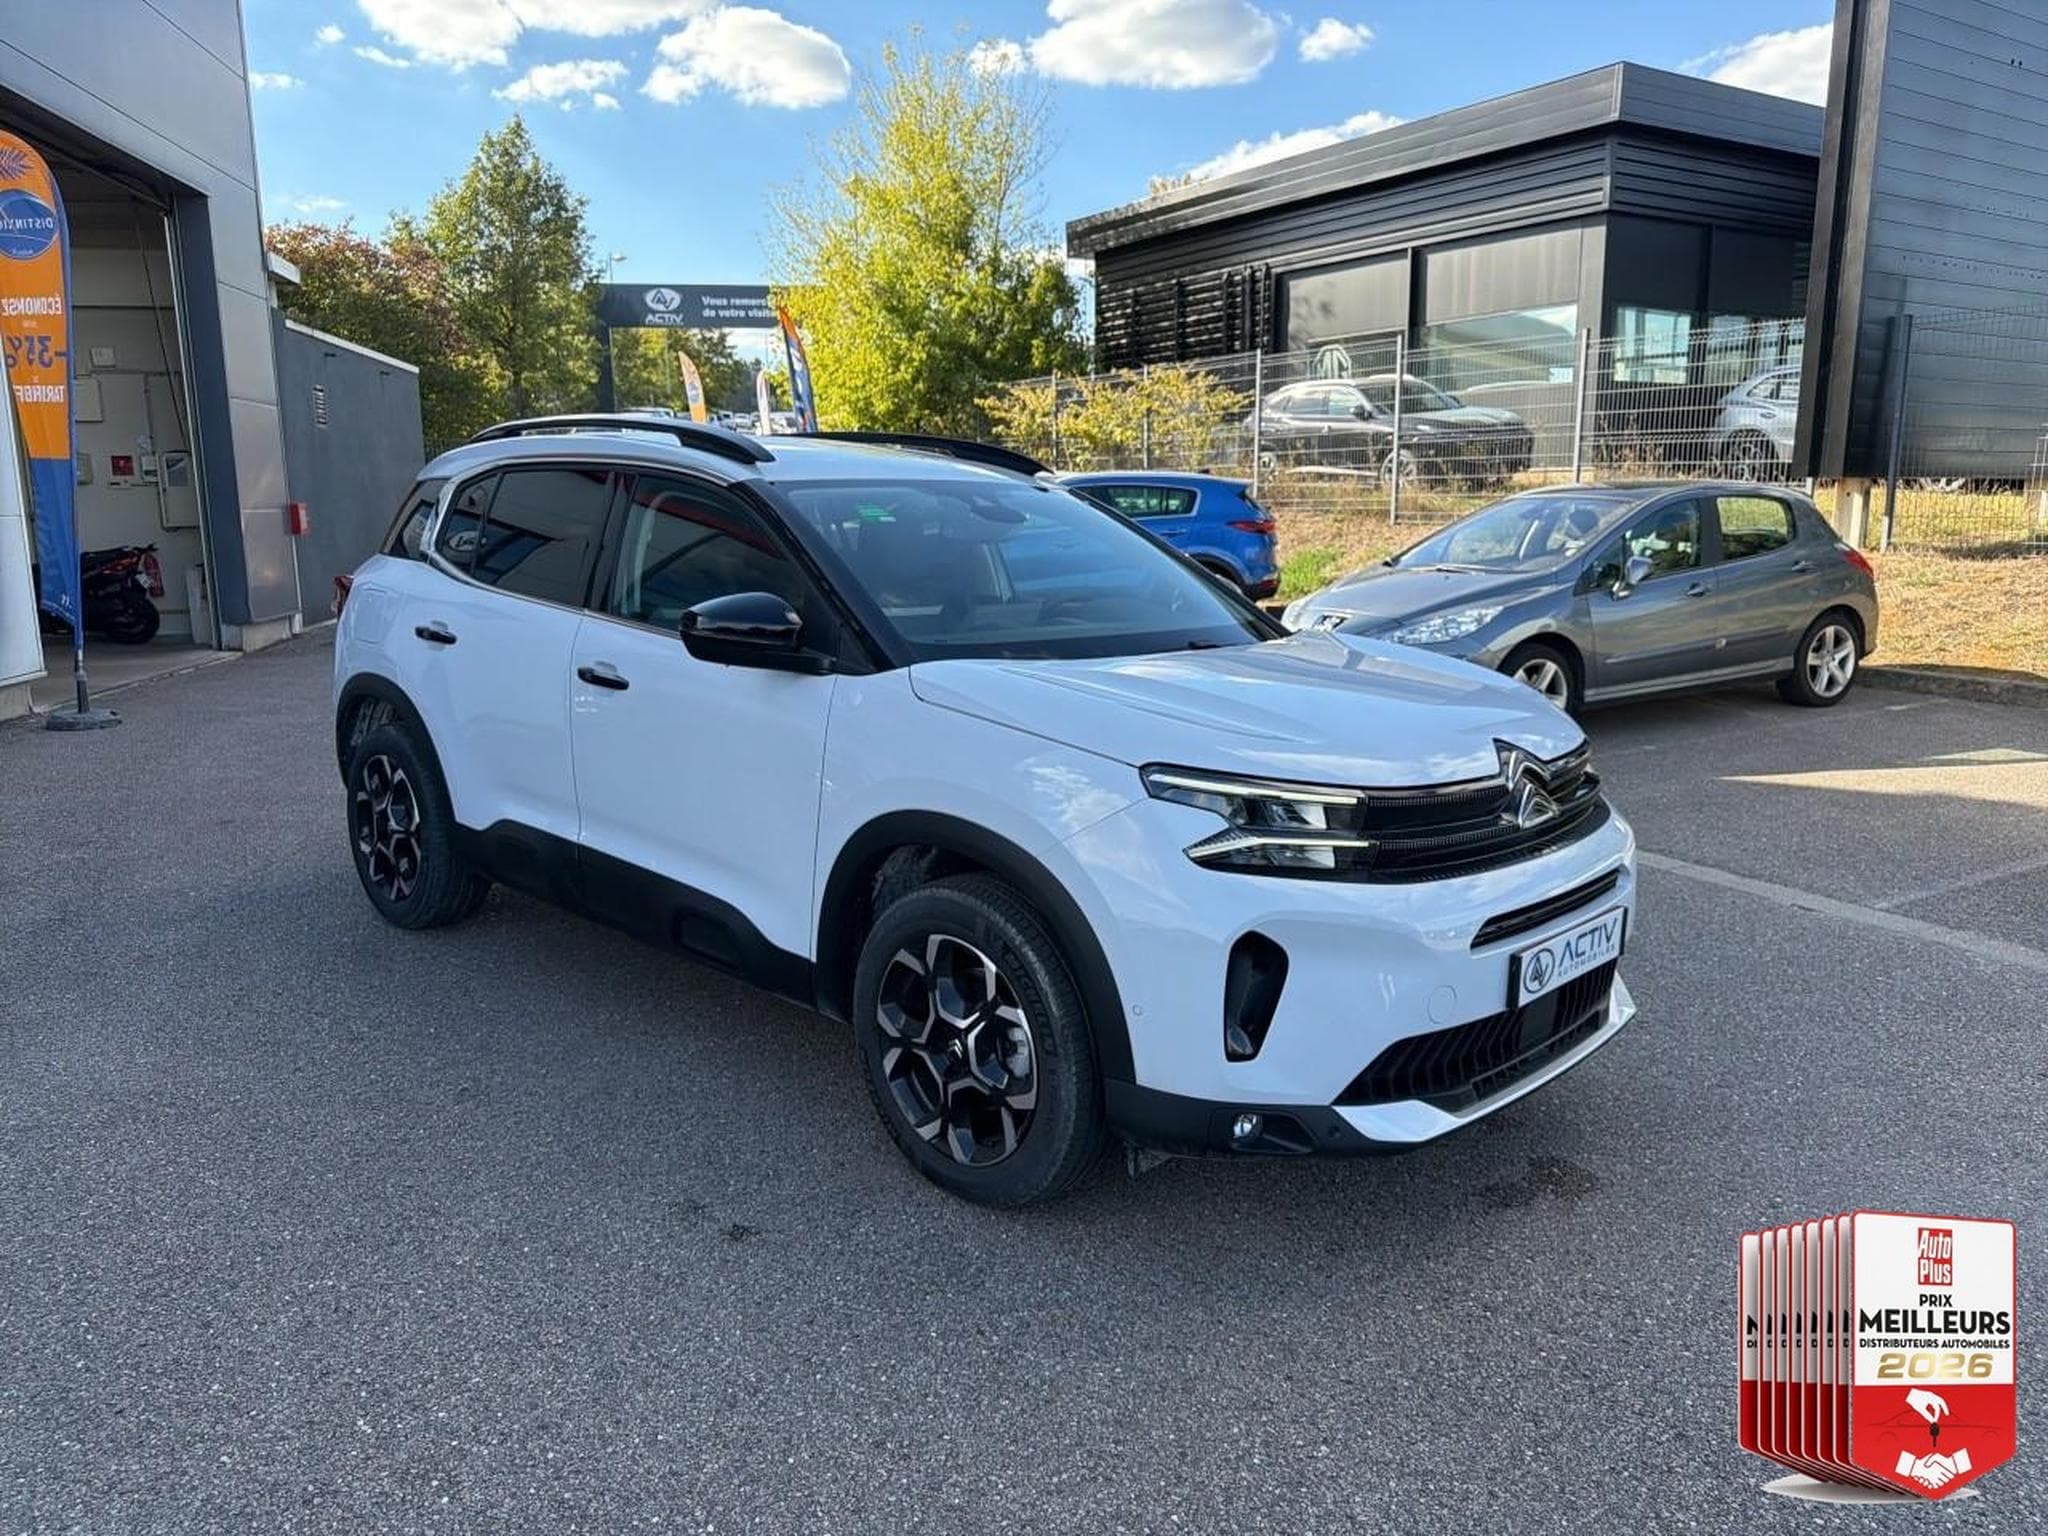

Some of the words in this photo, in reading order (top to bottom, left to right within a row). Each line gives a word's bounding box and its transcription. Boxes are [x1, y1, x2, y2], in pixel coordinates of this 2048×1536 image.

[701, 295, 728, 306] Vous
[702, 308, 719, 317] de
[720, 309, 746, 317] votre
[1560, 917, 1618, 967] ACTIV
